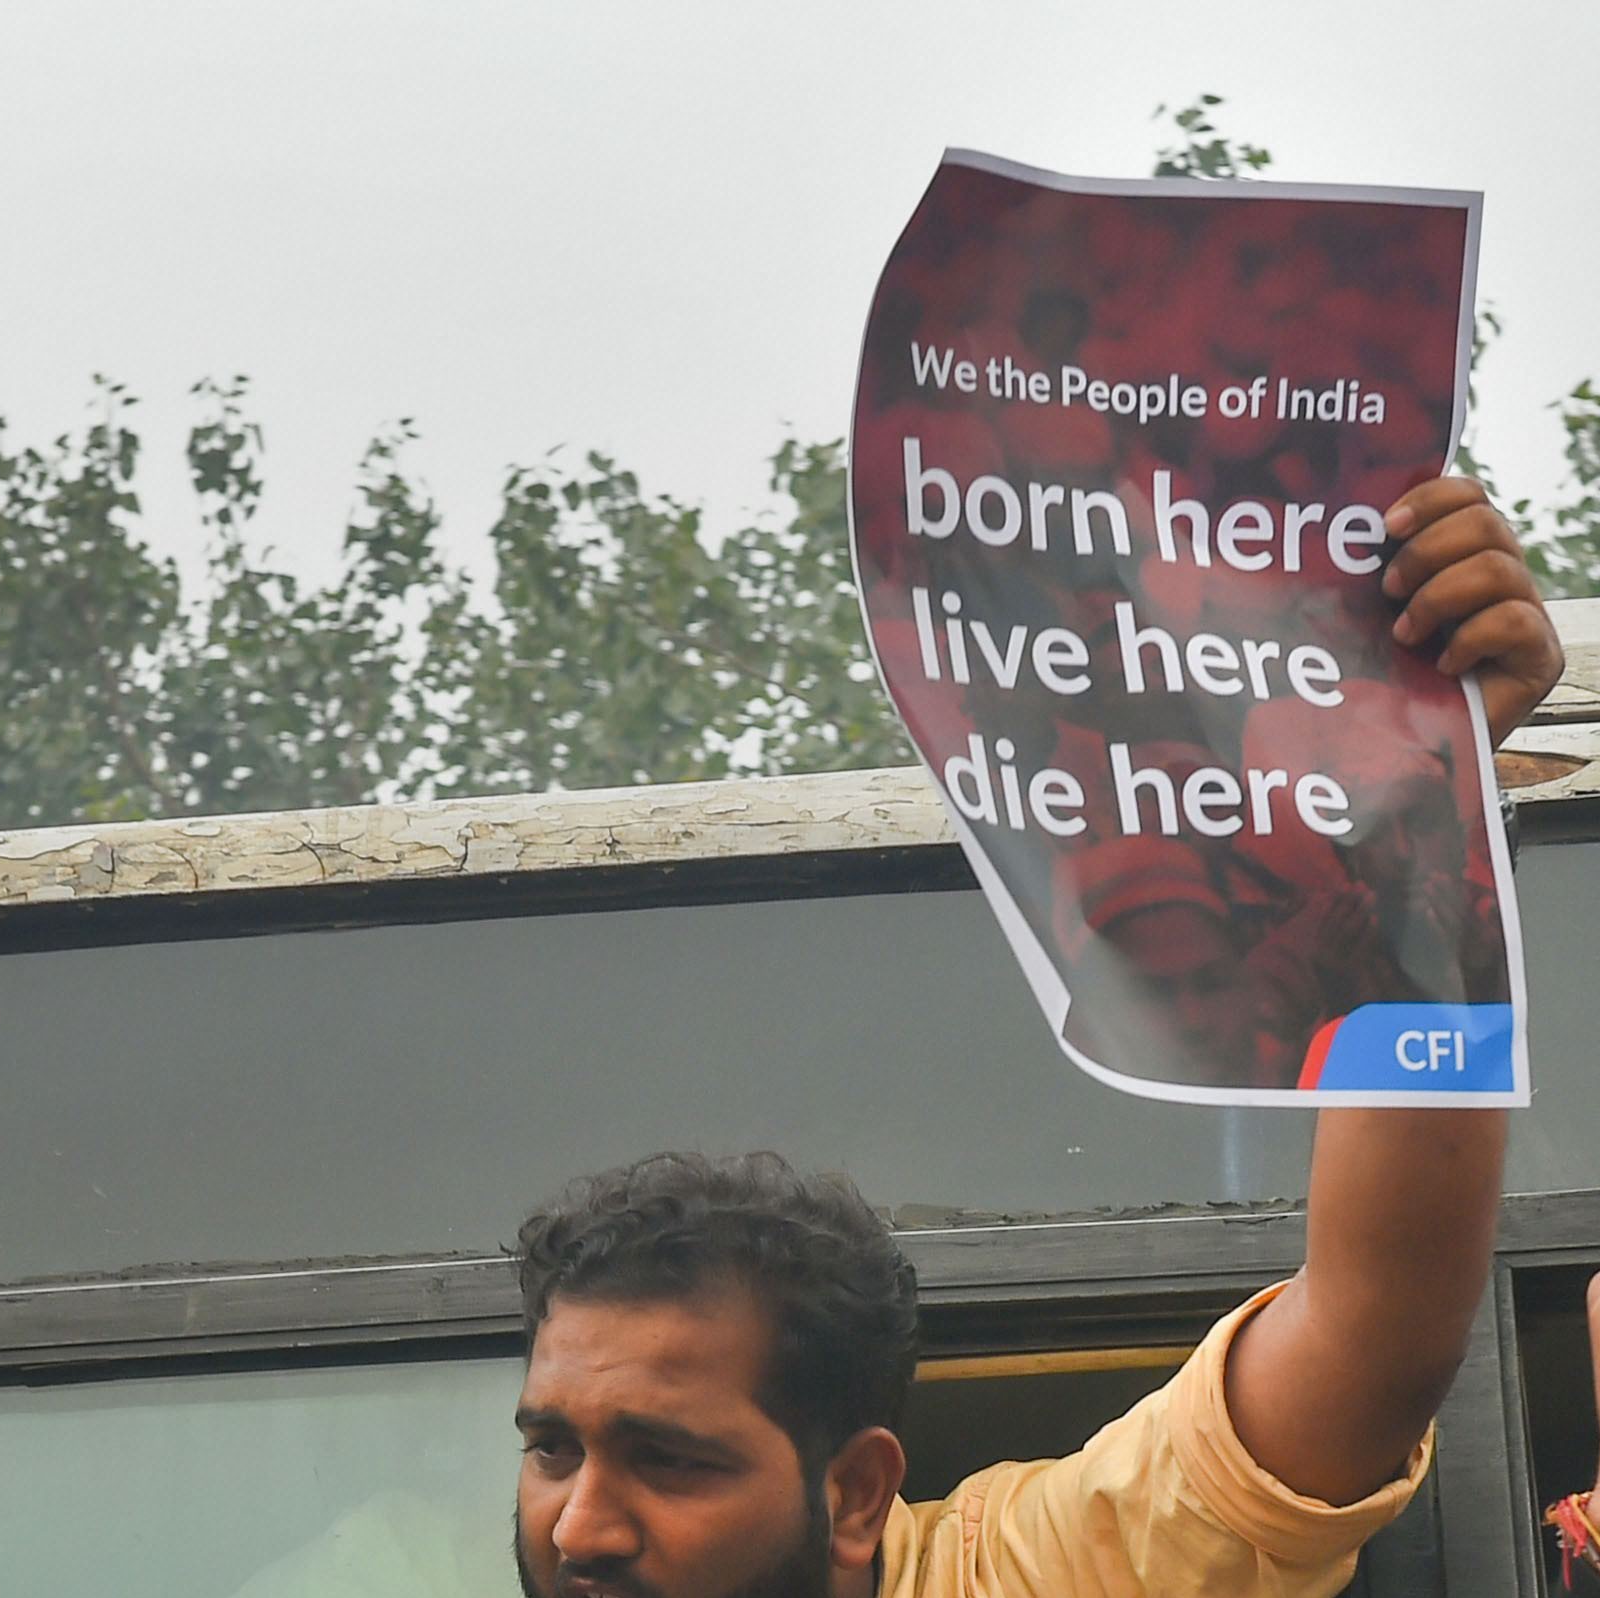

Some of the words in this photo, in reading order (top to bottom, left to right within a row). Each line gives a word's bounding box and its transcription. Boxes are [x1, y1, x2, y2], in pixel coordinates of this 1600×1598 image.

[911, 342, 977, 391] We
[985, 357, 1051, 403] the
[1061, 366, 1207, 424] People
[1218, 376, 1268, 419] of
[1277, 378, 1385, 424] India
[903, 437, 1131, 556] born
[1153, 470, 1386, 574] here
[912, 587, 1092, 694] live
[1115, 601, 1345, 708] here
[943, 733, 1087, 836] die
[1109, 742, 1353, 836] here
[1395, 1030, 1465, 1072] CFI
